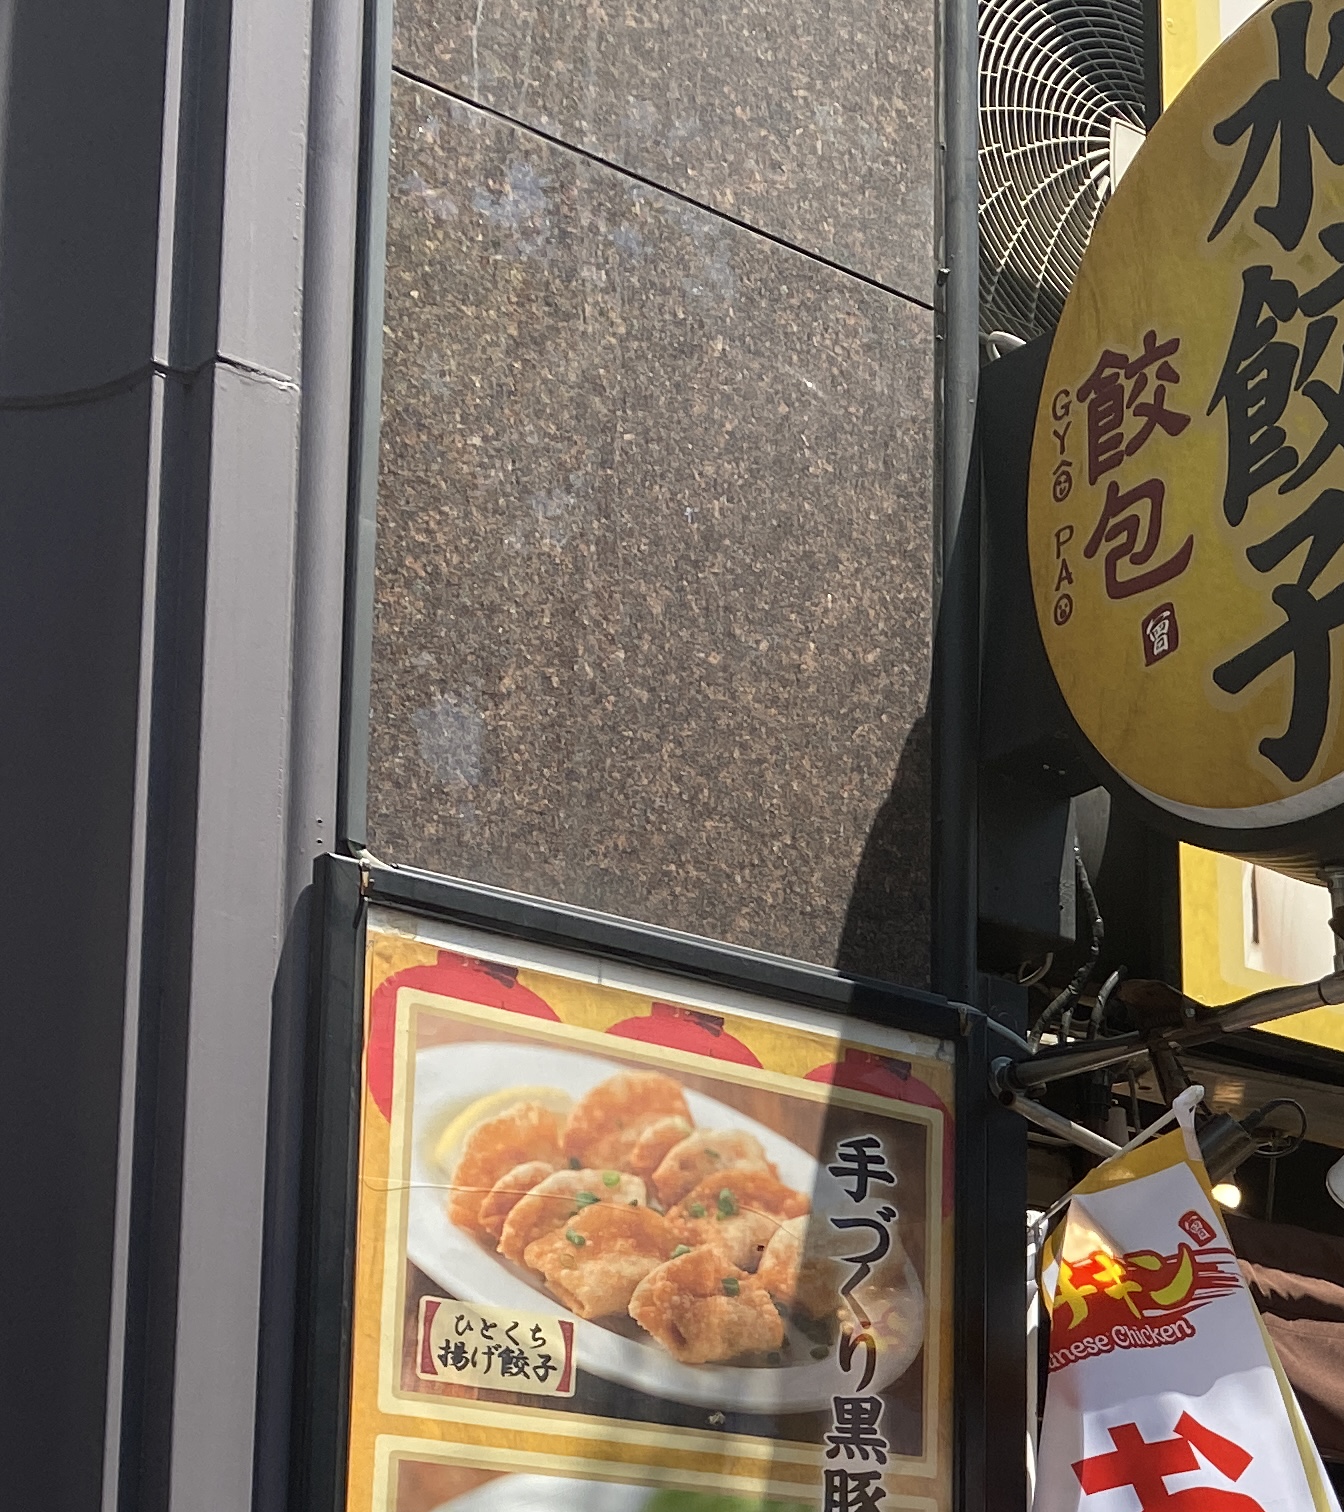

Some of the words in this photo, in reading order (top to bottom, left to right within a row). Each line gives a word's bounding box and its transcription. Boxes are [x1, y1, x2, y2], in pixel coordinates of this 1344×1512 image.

[1077, 328, 1194, 600] 餃包
[455, 1313, 547, 1349] ひとくち
[1111, 1317, 1193, 1347] Chicken
[437, 1338, 557, 1383] 揚げ餃子
